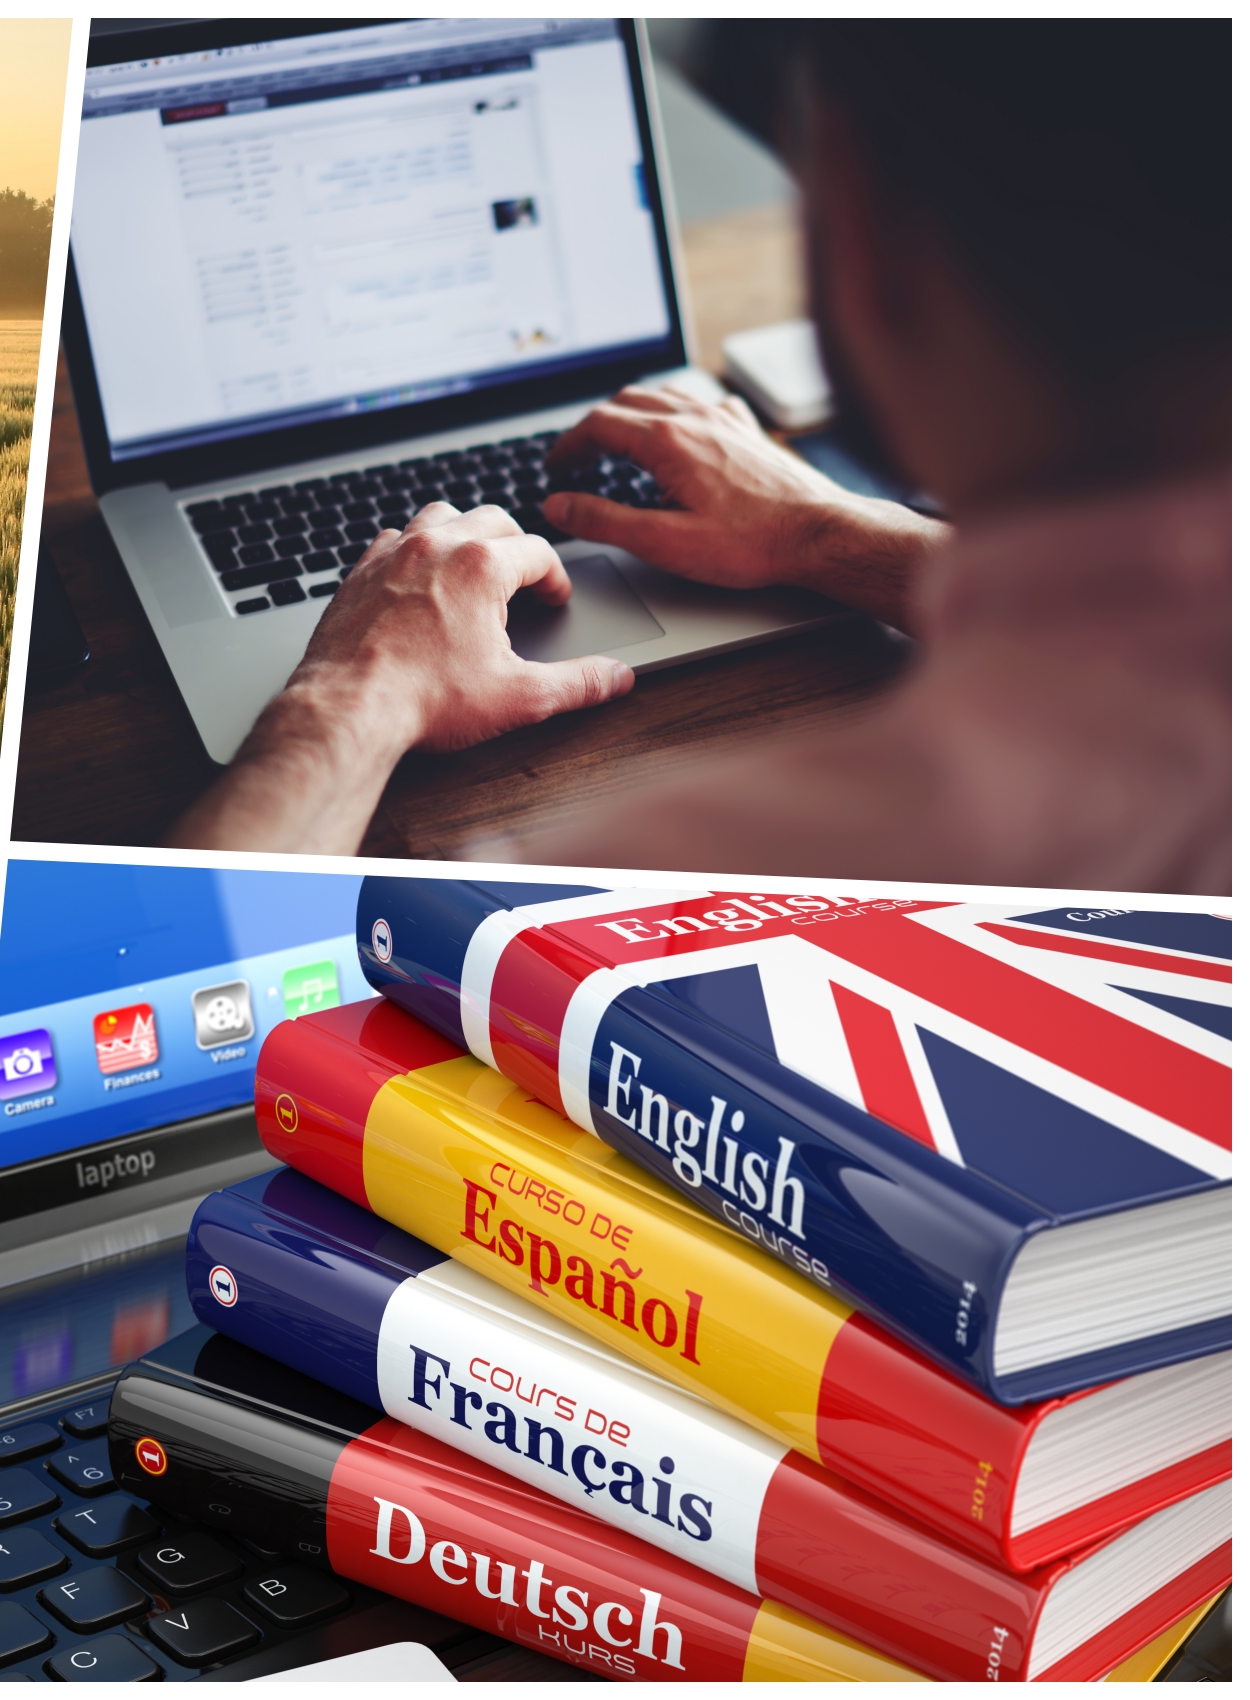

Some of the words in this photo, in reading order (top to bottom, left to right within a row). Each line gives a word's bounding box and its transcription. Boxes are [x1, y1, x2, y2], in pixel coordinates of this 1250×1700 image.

[791, 899, 918, 926] course
[209, 1045, 247, 1065] Video
[103, 1067, 161, 1092] Finances
[3, 1094, 56, 1117] Camera
[603, 1040, 807, 1241] English
[76, 1150, 156, 1188] laptop
[489, 1162, 586, 1227] CURSO
[589, 1212, 634, 1252] DE
[721, 1199, 832, 1287] course
[459, 1177, 704, 1367] Español
[955, 1279, 978, 1346] 2014
[74, 1408, 95, 1420] F7
[407, 1344, 713, 1542] Français
[82, 1467, 104, 1480] 6
[970, 1459, 994, 1522] 2014
[74, 1509, 97, 1525] T
[156, 1548, 185, 1564] G
[60, 1582, 80, 1600] F
[258, 1579, 287, 1597] B
[368, 1496, 687, 1672] Deutsch
[164, 1613, 190, 1631] V
[70, 1651, 98, 1668] C
[538, 1624, 636, 1675] KURS
[986, 1624, 1010, 1681] 2014
